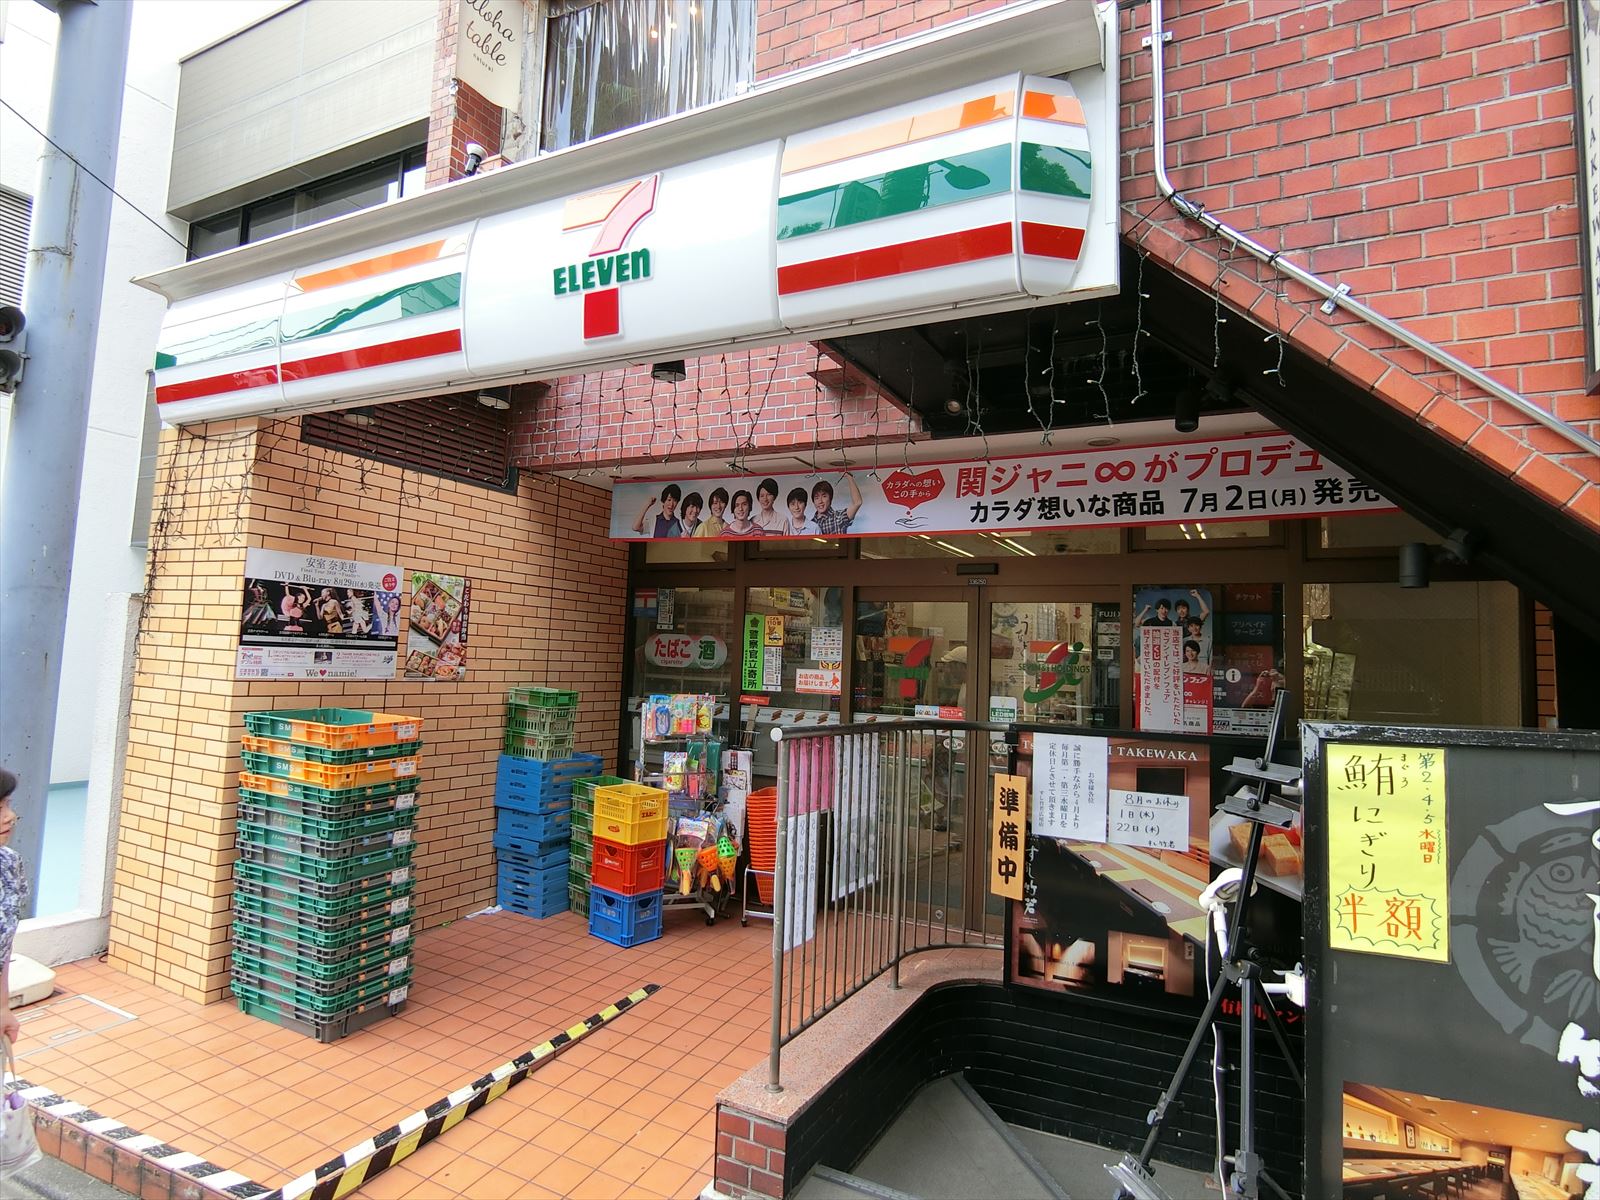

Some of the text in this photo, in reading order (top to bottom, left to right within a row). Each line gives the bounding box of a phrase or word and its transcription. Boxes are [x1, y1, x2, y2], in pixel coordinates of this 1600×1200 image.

[466, 21, 507, 66] table
[885, 477, 942, 490] カラダへの想い
[892, 489, 931, 498] この手から
[969, 477, 1380, 524] カラダ想いな商品 7月2日(月)発売
[274, 570, 295, 580] DVD
[302, 573, 332, 586] Blu-ray
[654, 638, 716, 661] たばこ 酒
[747, 629, 759, 690] 警察官立寄所
[305, 669, 358, 678] We namie!
[1052, 664, 1090, 674] HOLDINGS
[1116, 746, 1199, 762] TAKEWAKA
[1399, 753, 1410, 789] まぐろ
[998, 786, 1020, 885] 準備中
[1337, 892, 1423, 940] 半額
